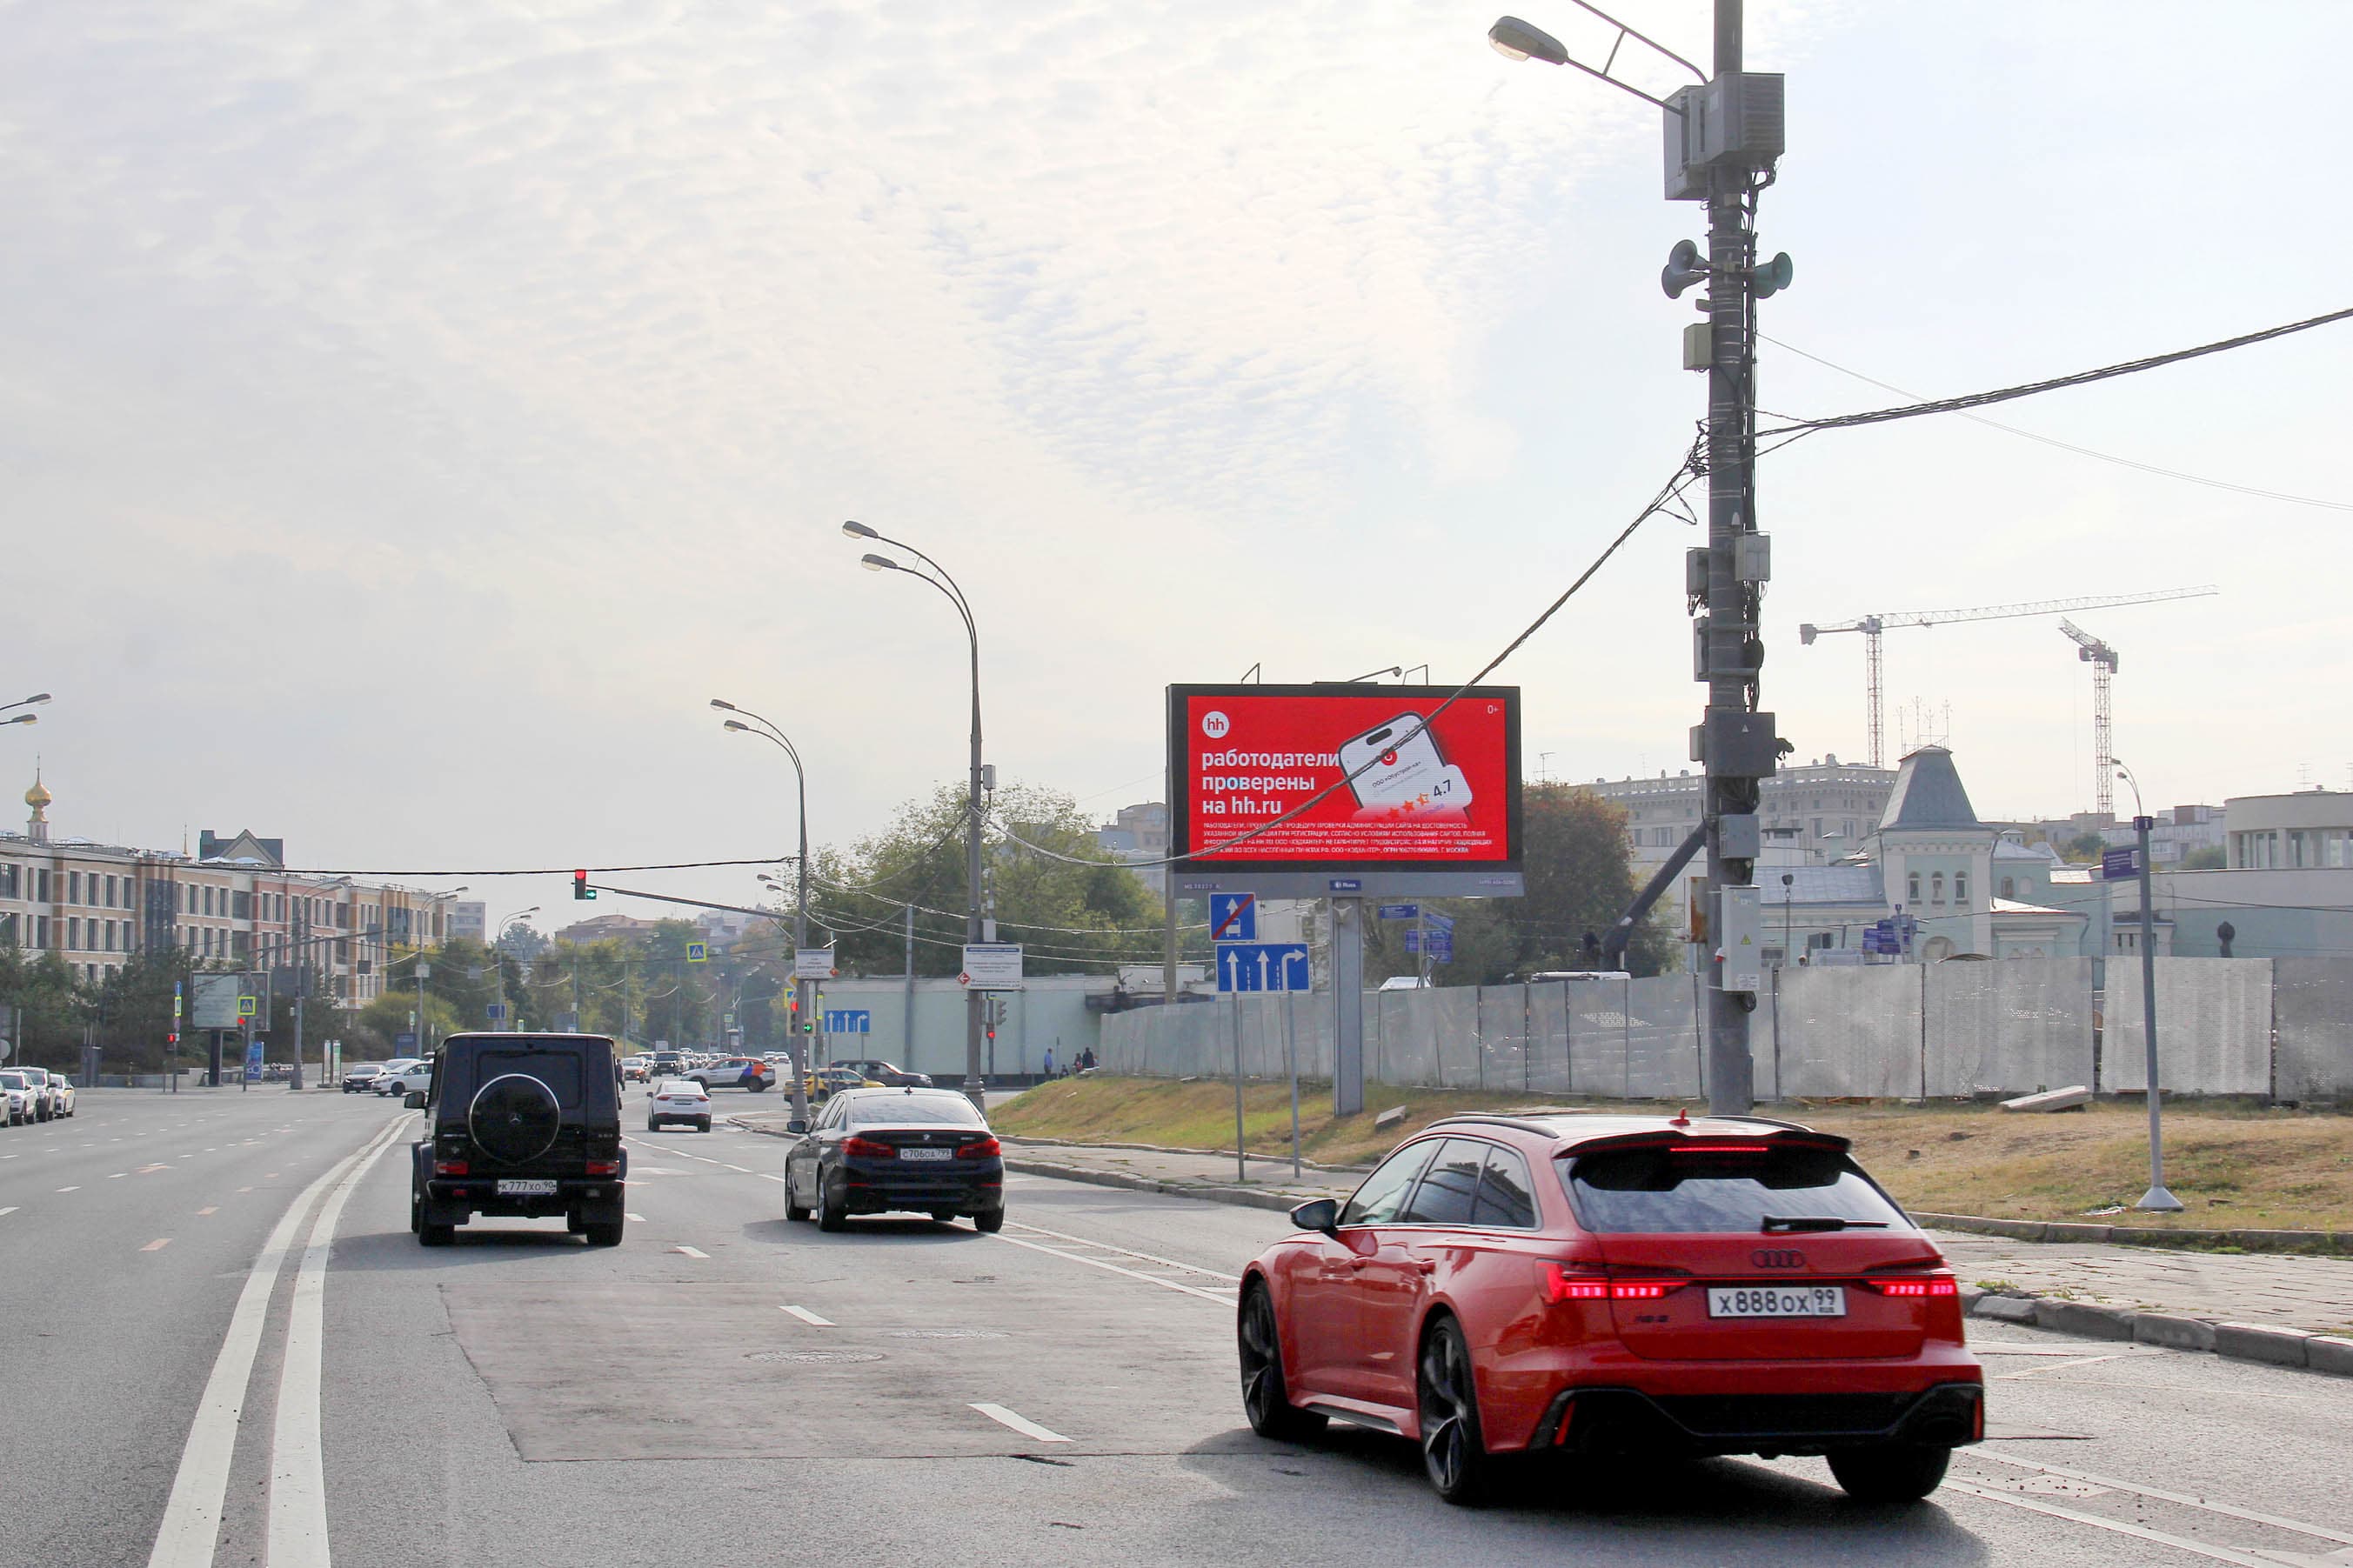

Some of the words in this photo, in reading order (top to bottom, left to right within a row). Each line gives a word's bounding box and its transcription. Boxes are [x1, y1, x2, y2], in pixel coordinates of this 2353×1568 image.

[1487, 704, 1499, 715] 0+
[1207, 717, 1225, 731] hh
[1202, 748, 1340, 771] работодатели
[1202, 776, 1315, 795] проверены
[1434, 779, 1451, 797] 4.7
[1202, 800, 1226, 814] на
[1231, 796, 1282, 814] hh.ru
